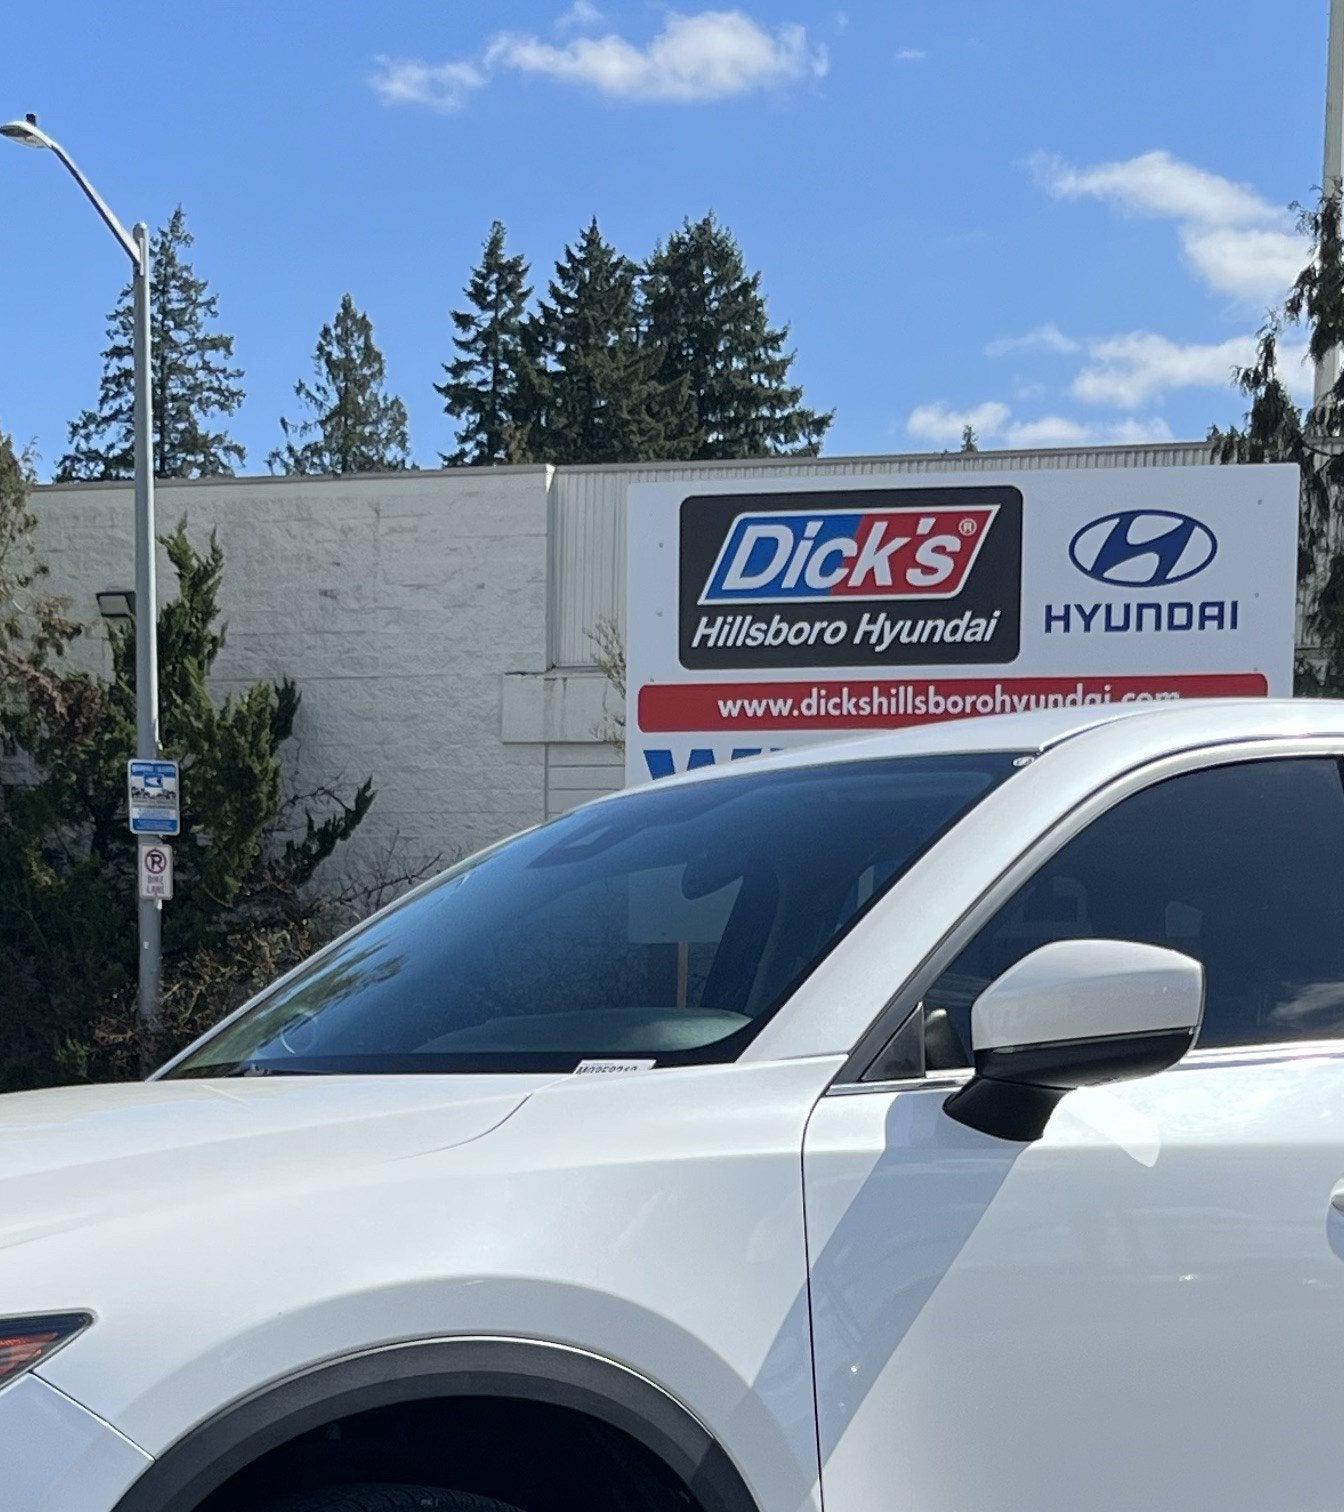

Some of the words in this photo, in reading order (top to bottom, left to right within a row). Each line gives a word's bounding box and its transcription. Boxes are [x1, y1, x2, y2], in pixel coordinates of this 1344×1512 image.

[692, 615, 848, 649] Hillsboro
[854, 612, 1001, 653] Hyundai
[1044, 600, 1238, 635] HYUNDAI
